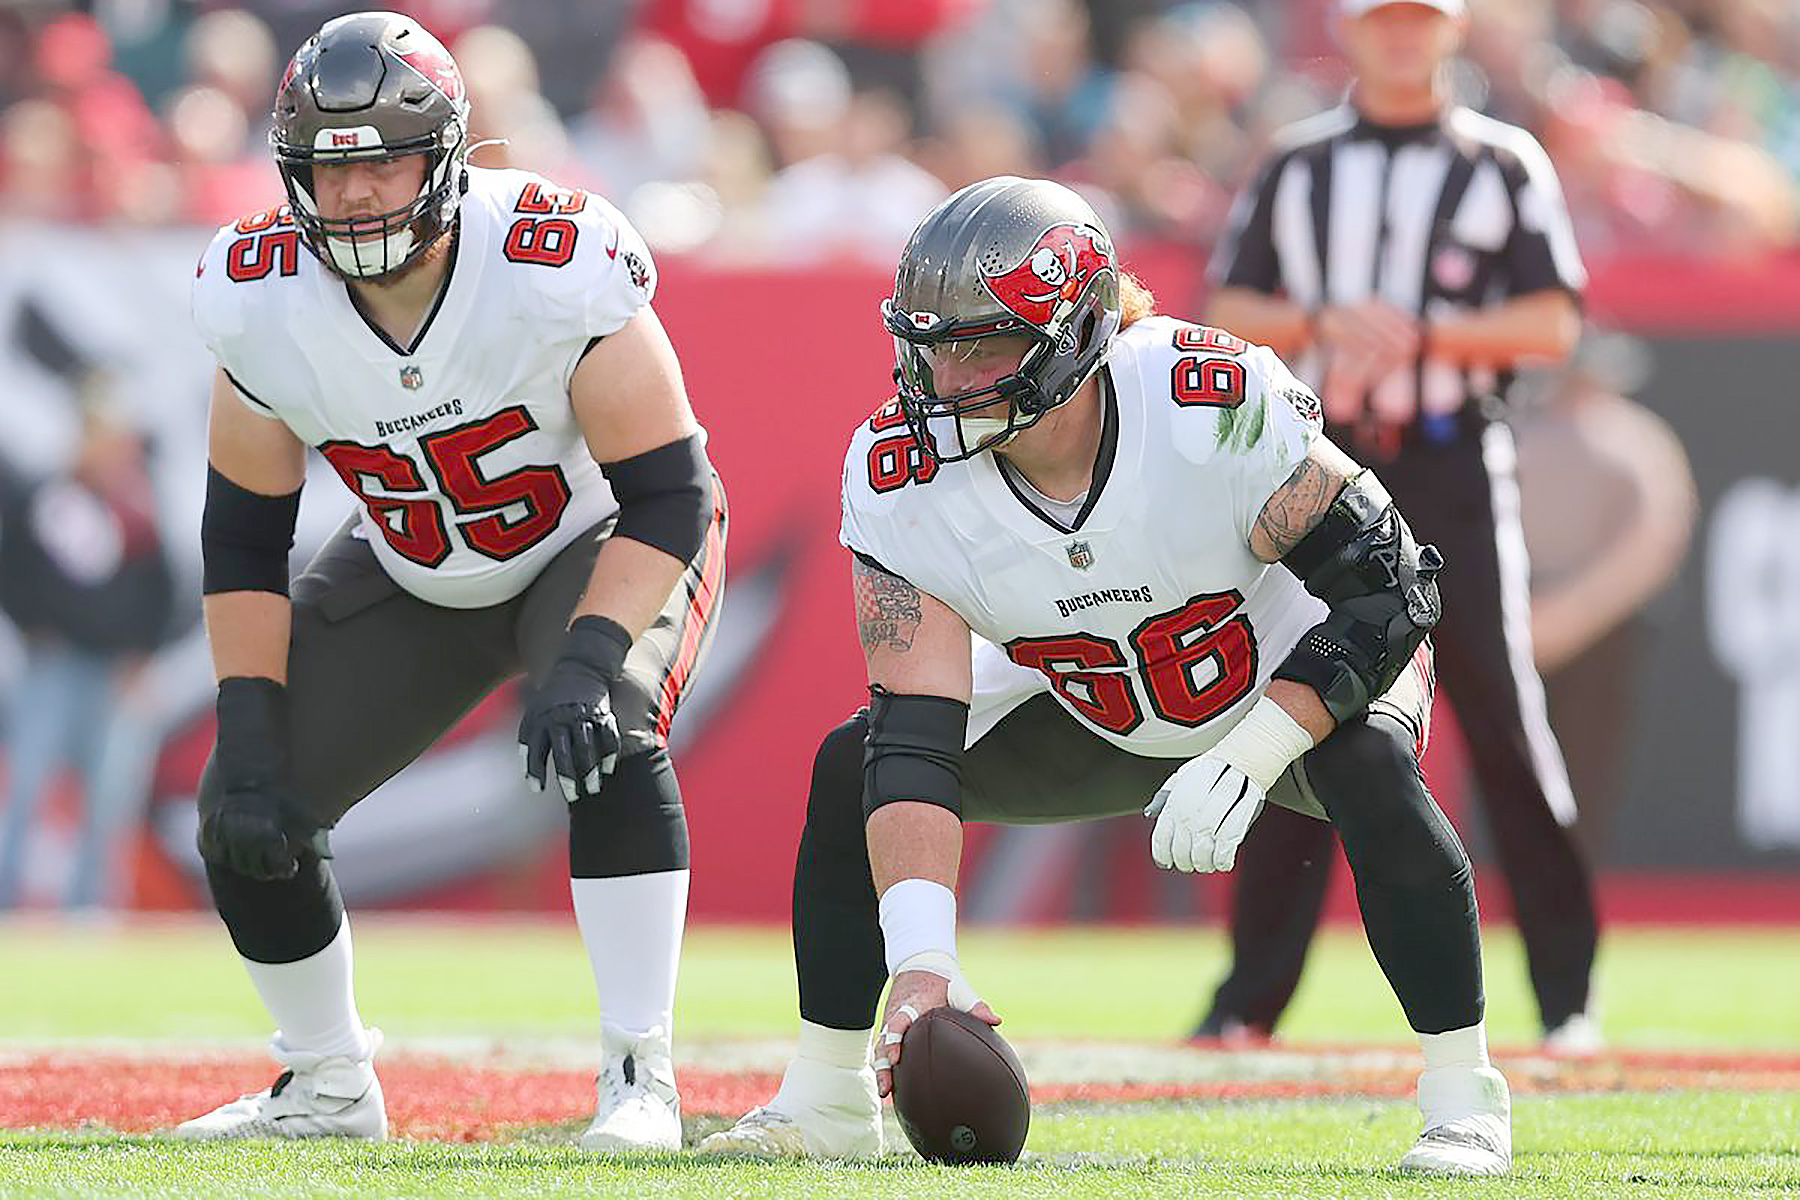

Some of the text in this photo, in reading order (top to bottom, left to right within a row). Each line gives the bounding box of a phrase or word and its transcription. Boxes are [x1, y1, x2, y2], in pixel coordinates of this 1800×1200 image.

[502, 182, 588, 269] 65
[1170, 327, 1248, 410] 66
[375, 398, 463, 437] BUCCANEERS
[315, 404, 573, 570] 65
[1055, 585, 1153, 618] BUCCANEERS
[1001, 587, 1259, 737] 66
